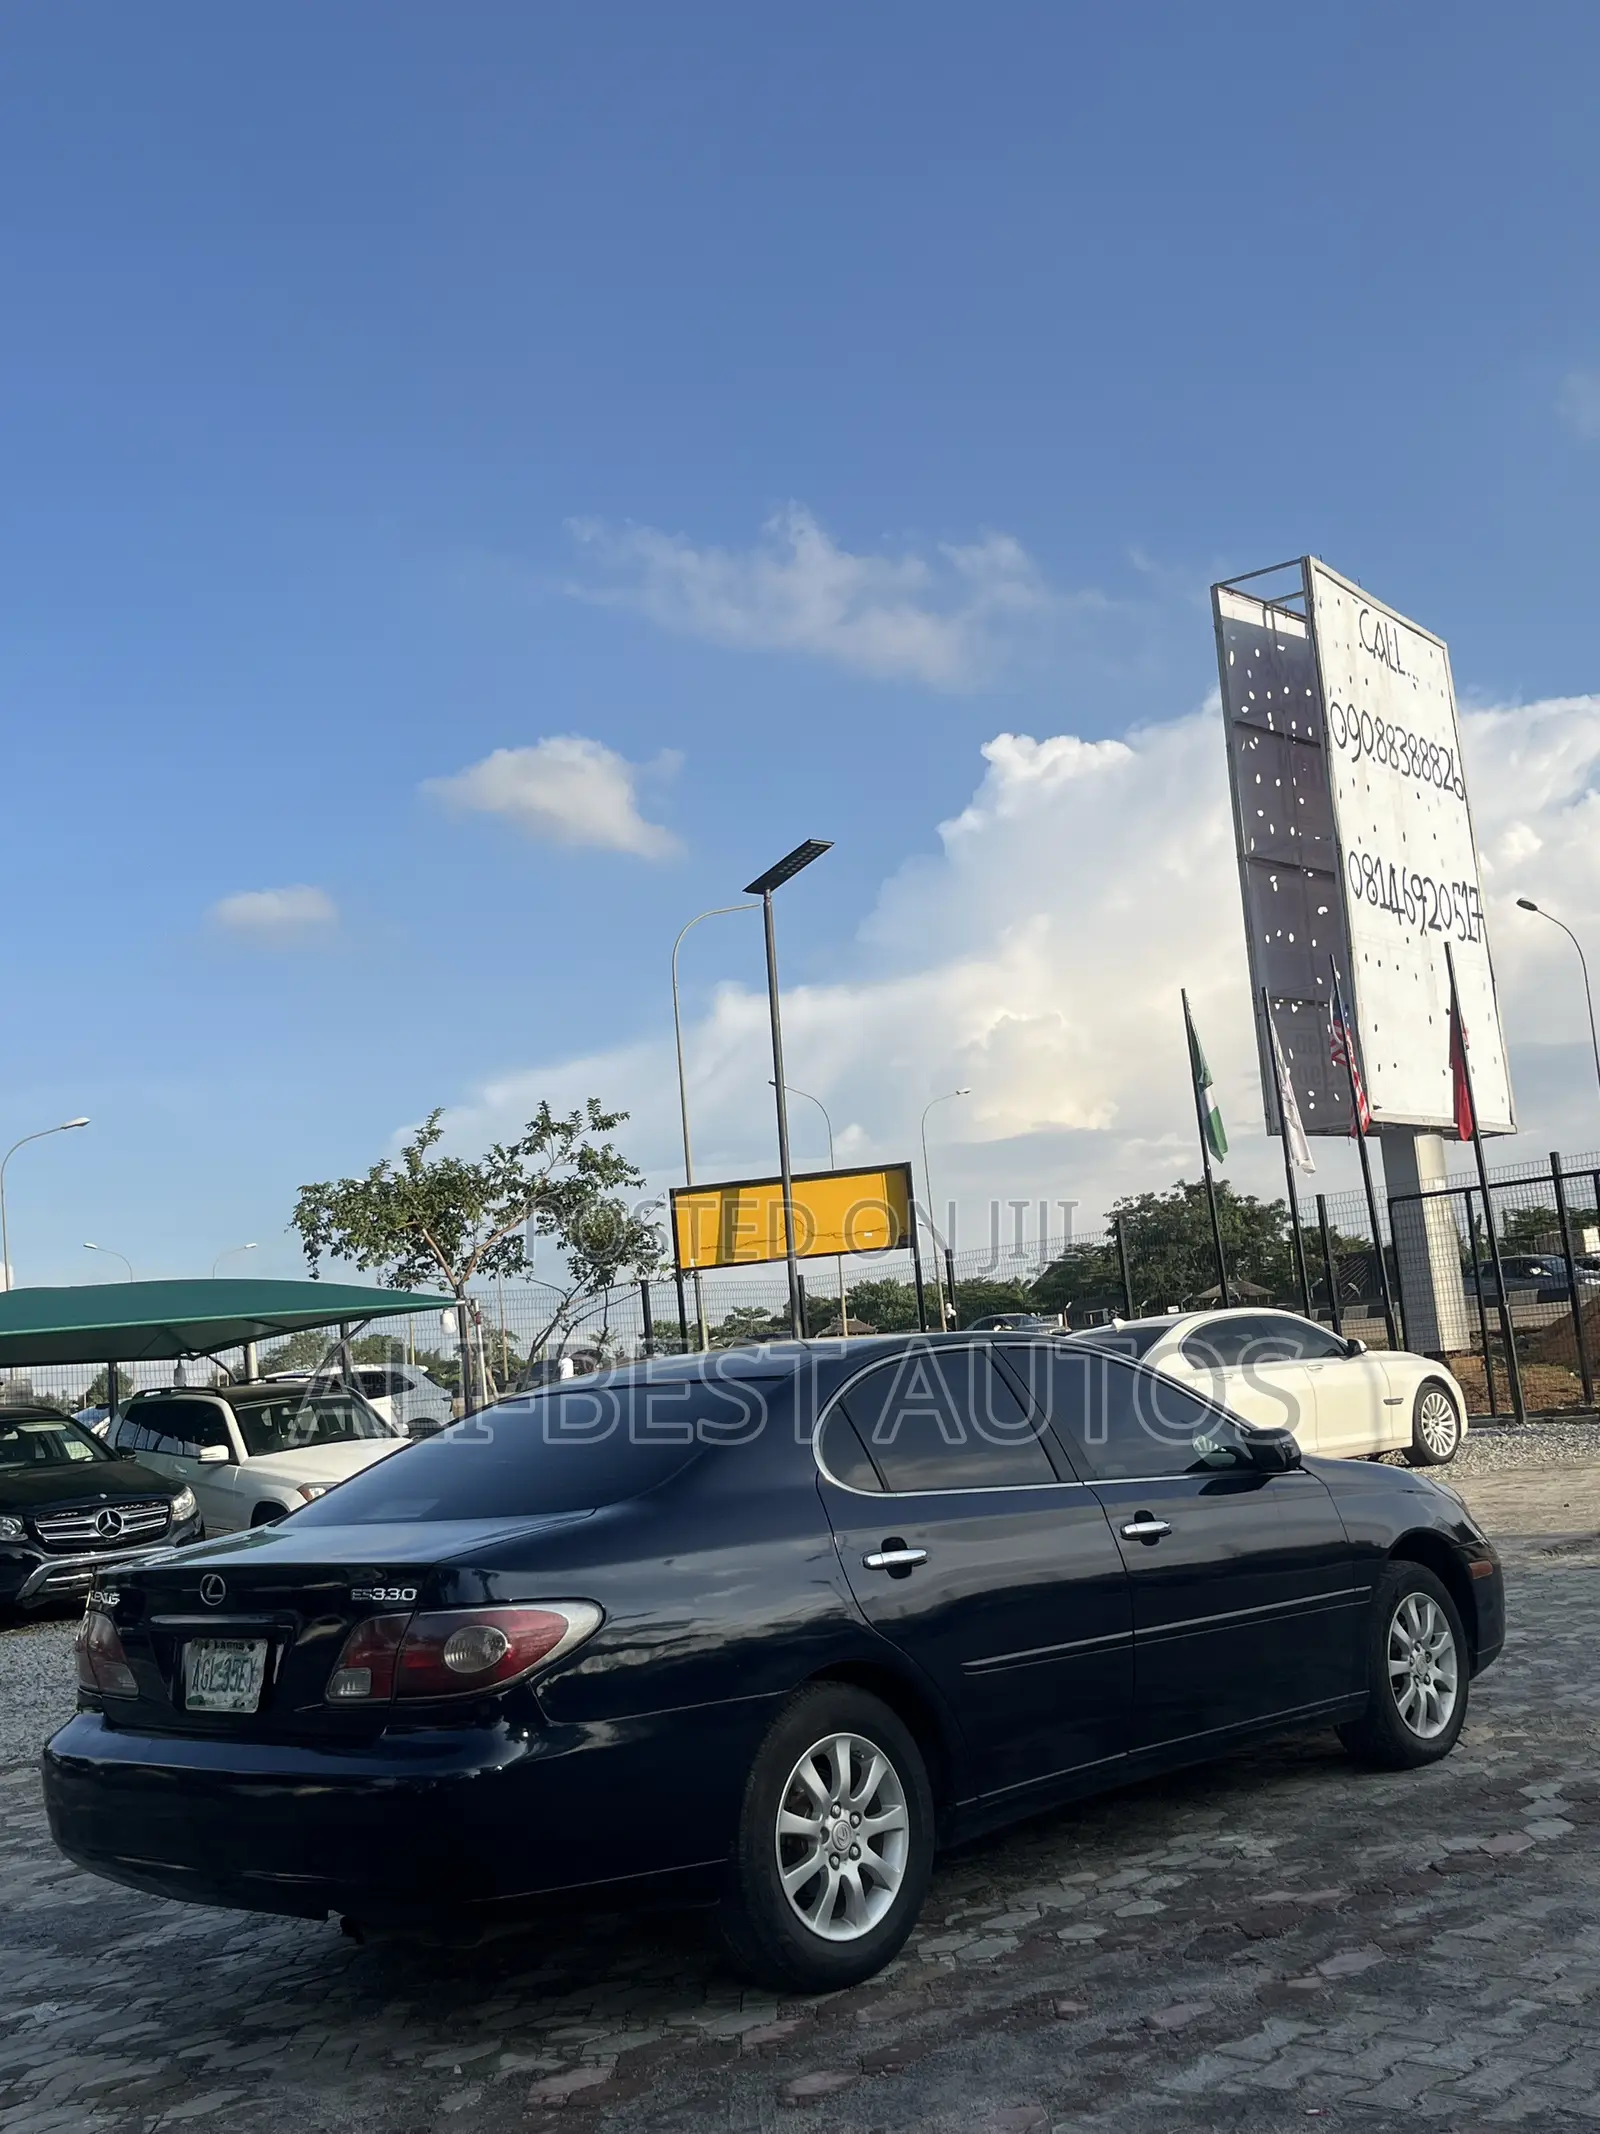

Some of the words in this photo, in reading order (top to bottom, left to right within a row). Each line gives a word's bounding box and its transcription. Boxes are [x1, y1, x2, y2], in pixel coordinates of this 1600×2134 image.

[1330, 702, 1464, 801] 09088388826
[1348, 851, 1484, 943] 08146920517
[351, 1587, 418, 1601] ES330
